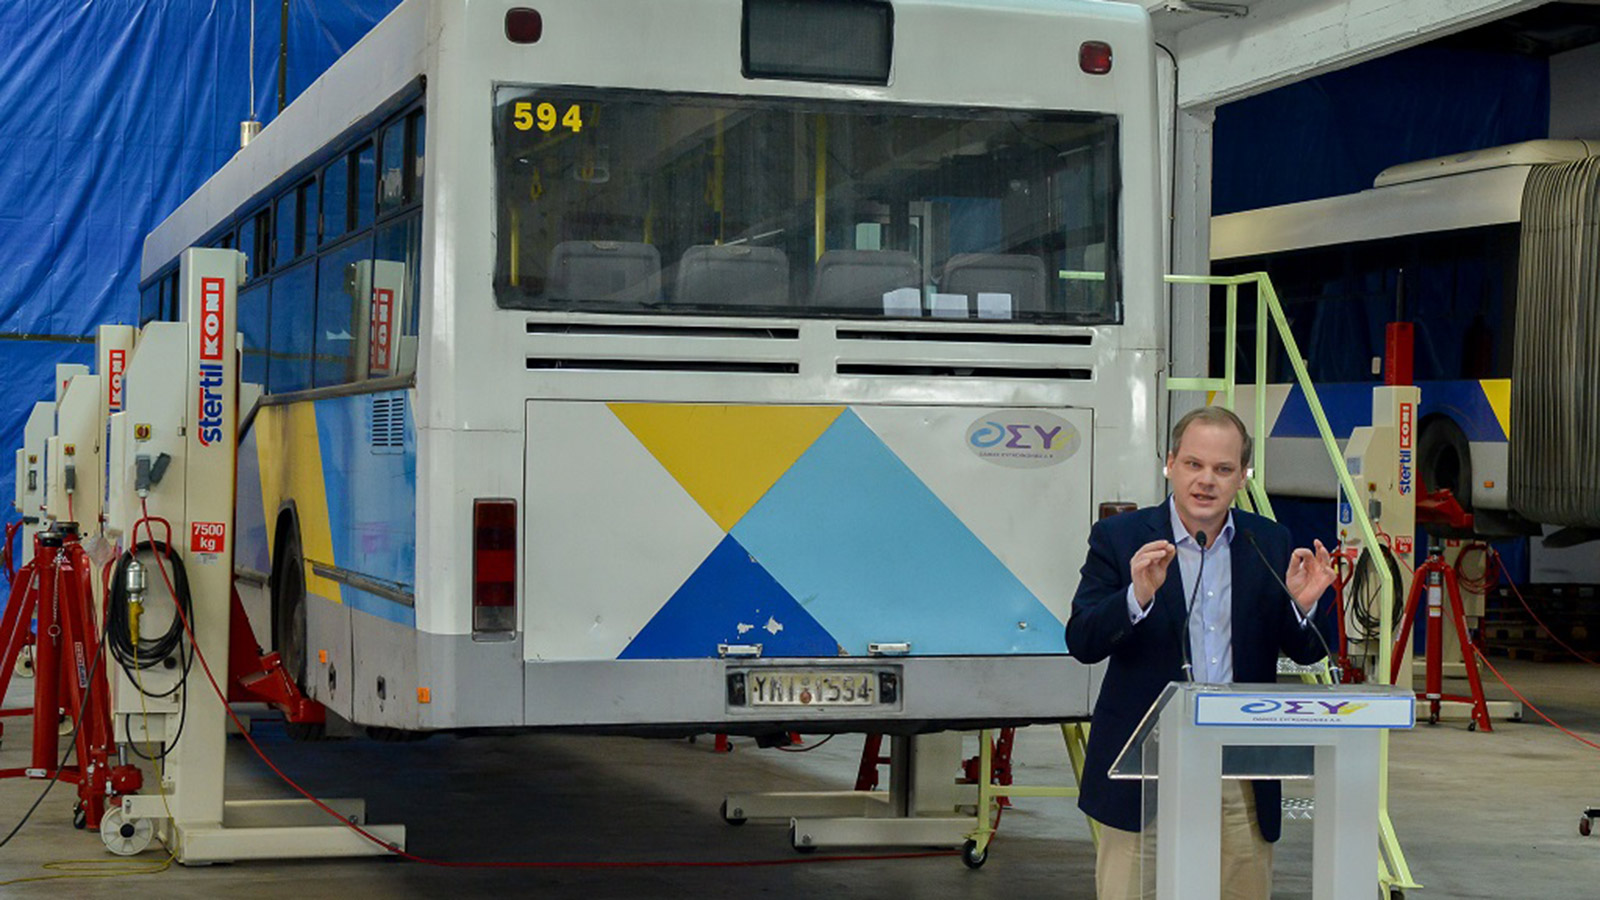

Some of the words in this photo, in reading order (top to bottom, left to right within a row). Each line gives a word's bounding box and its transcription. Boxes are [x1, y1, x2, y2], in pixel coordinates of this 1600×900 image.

[513, 102, 582, 132] 594
[204, 282, 220, 356] KONI
[112, 352, 123, 403] KONI
[198, 364, 223, 445] stertil
[1401, 405, 1410, 446] KONI
[1399, 450, 1411, 495] stertil
[193, 523, 224, 536] 7500
[200, 537, 216, 551] kg
